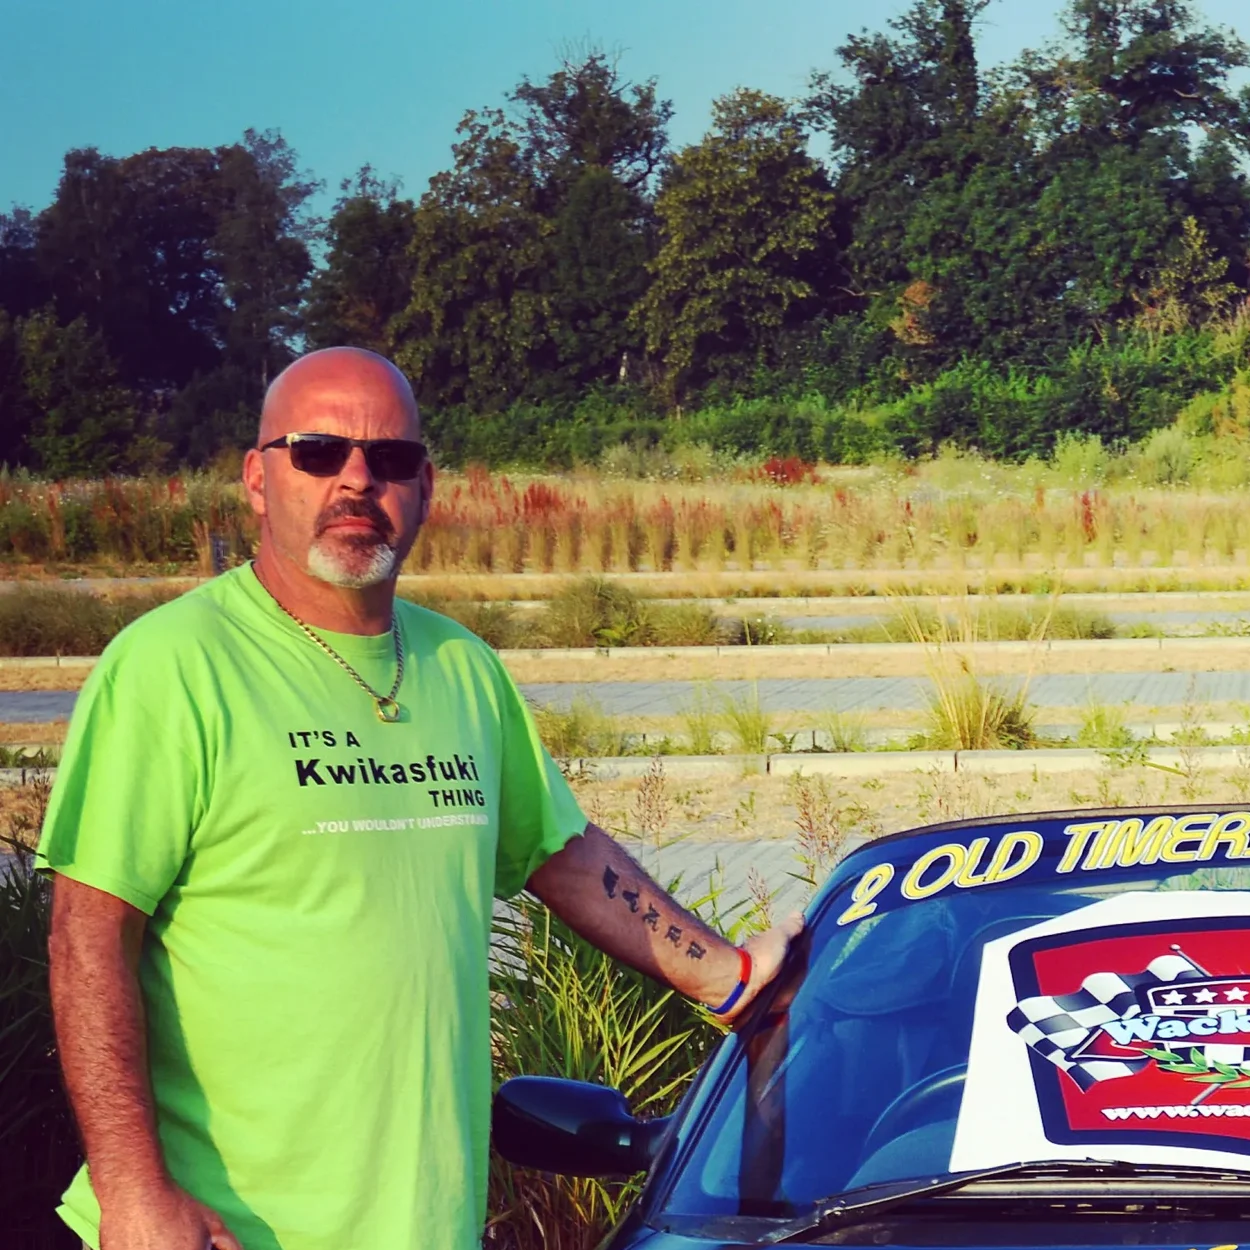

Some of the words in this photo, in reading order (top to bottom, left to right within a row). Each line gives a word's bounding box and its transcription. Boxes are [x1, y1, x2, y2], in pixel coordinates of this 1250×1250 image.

[288, 731, 337, 748] IT'S
[346, 731, 361, 747] A
[295, 754, 479, 787] Kwikasfuki
[428, 789, 485, 807] THING
[352, 817, 414, 832] WOULDN'T
[837, 863, 895, 926] 2
[900, 830, 1044, 900] OLD
